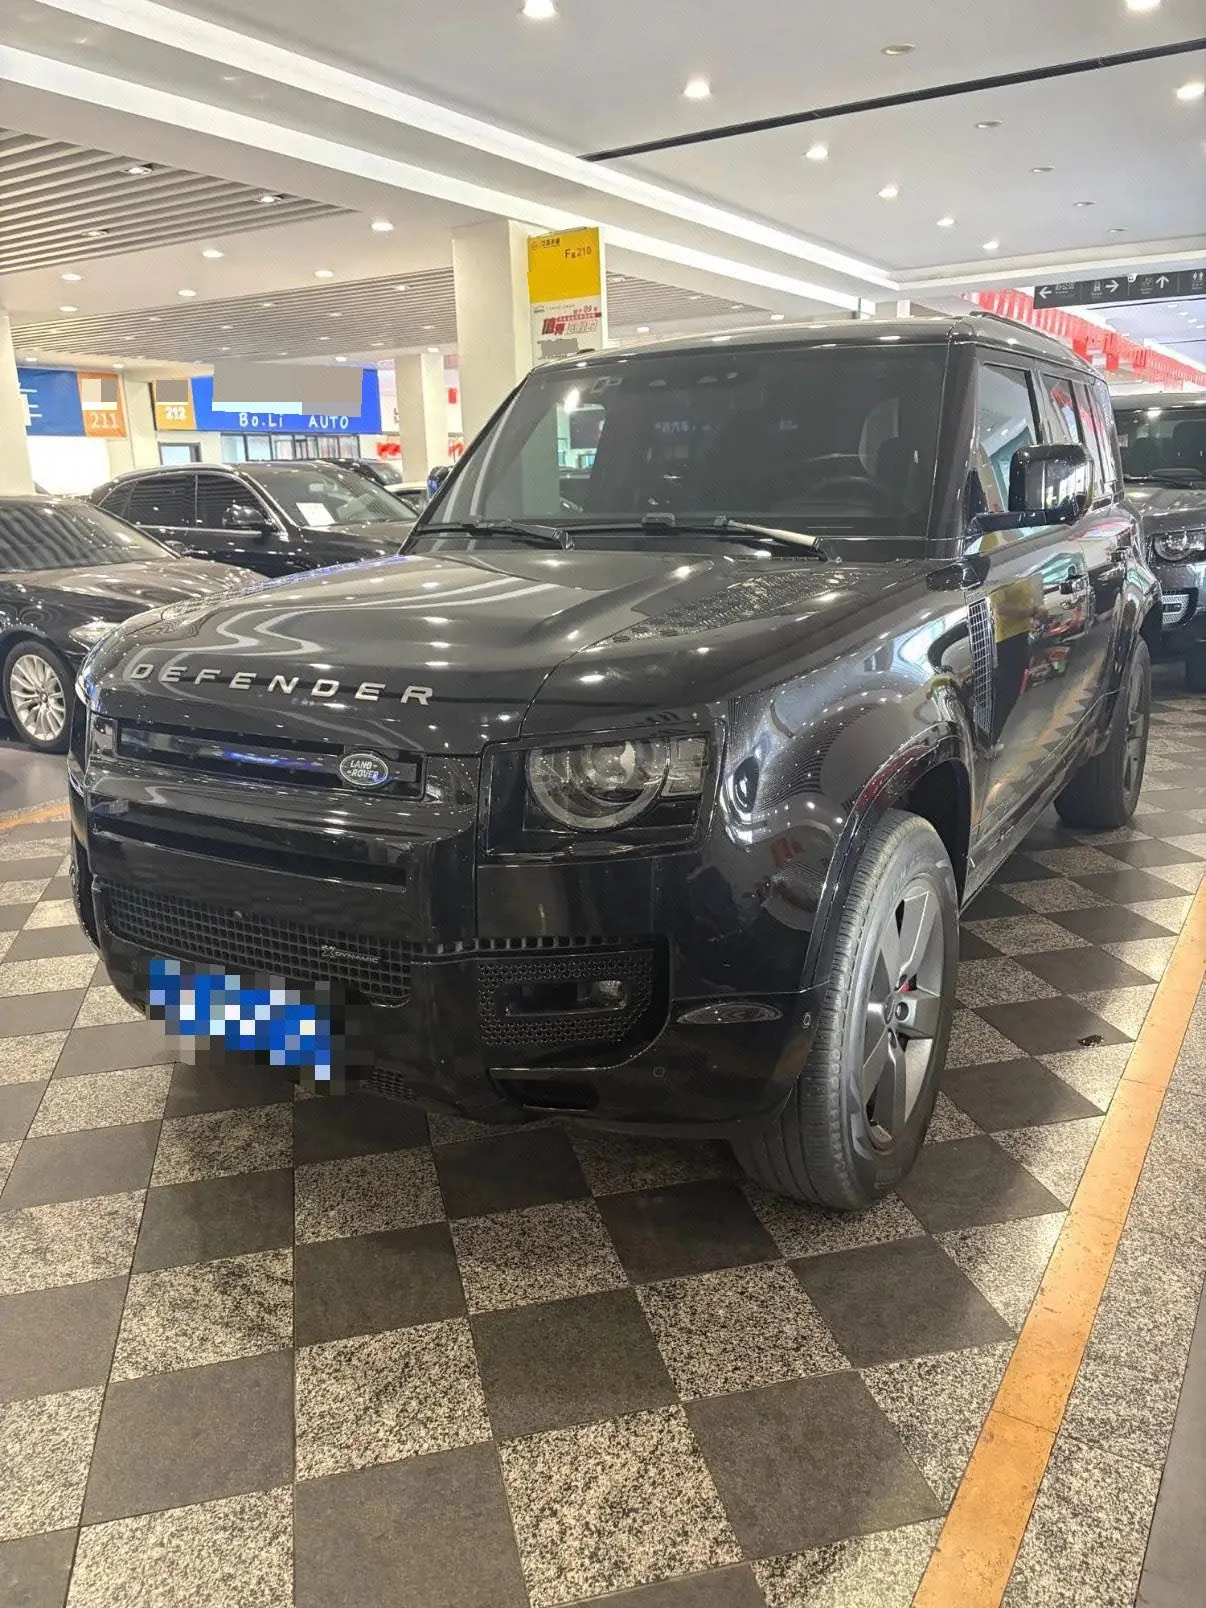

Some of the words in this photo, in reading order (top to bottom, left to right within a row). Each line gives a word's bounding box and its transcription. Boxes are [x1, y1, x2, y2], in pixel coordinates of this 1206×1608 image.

[89, 412, 119, 429] 211
[308, 415, 349, 429] AUTO
[130, 663, 433, 706] DEFENDER
